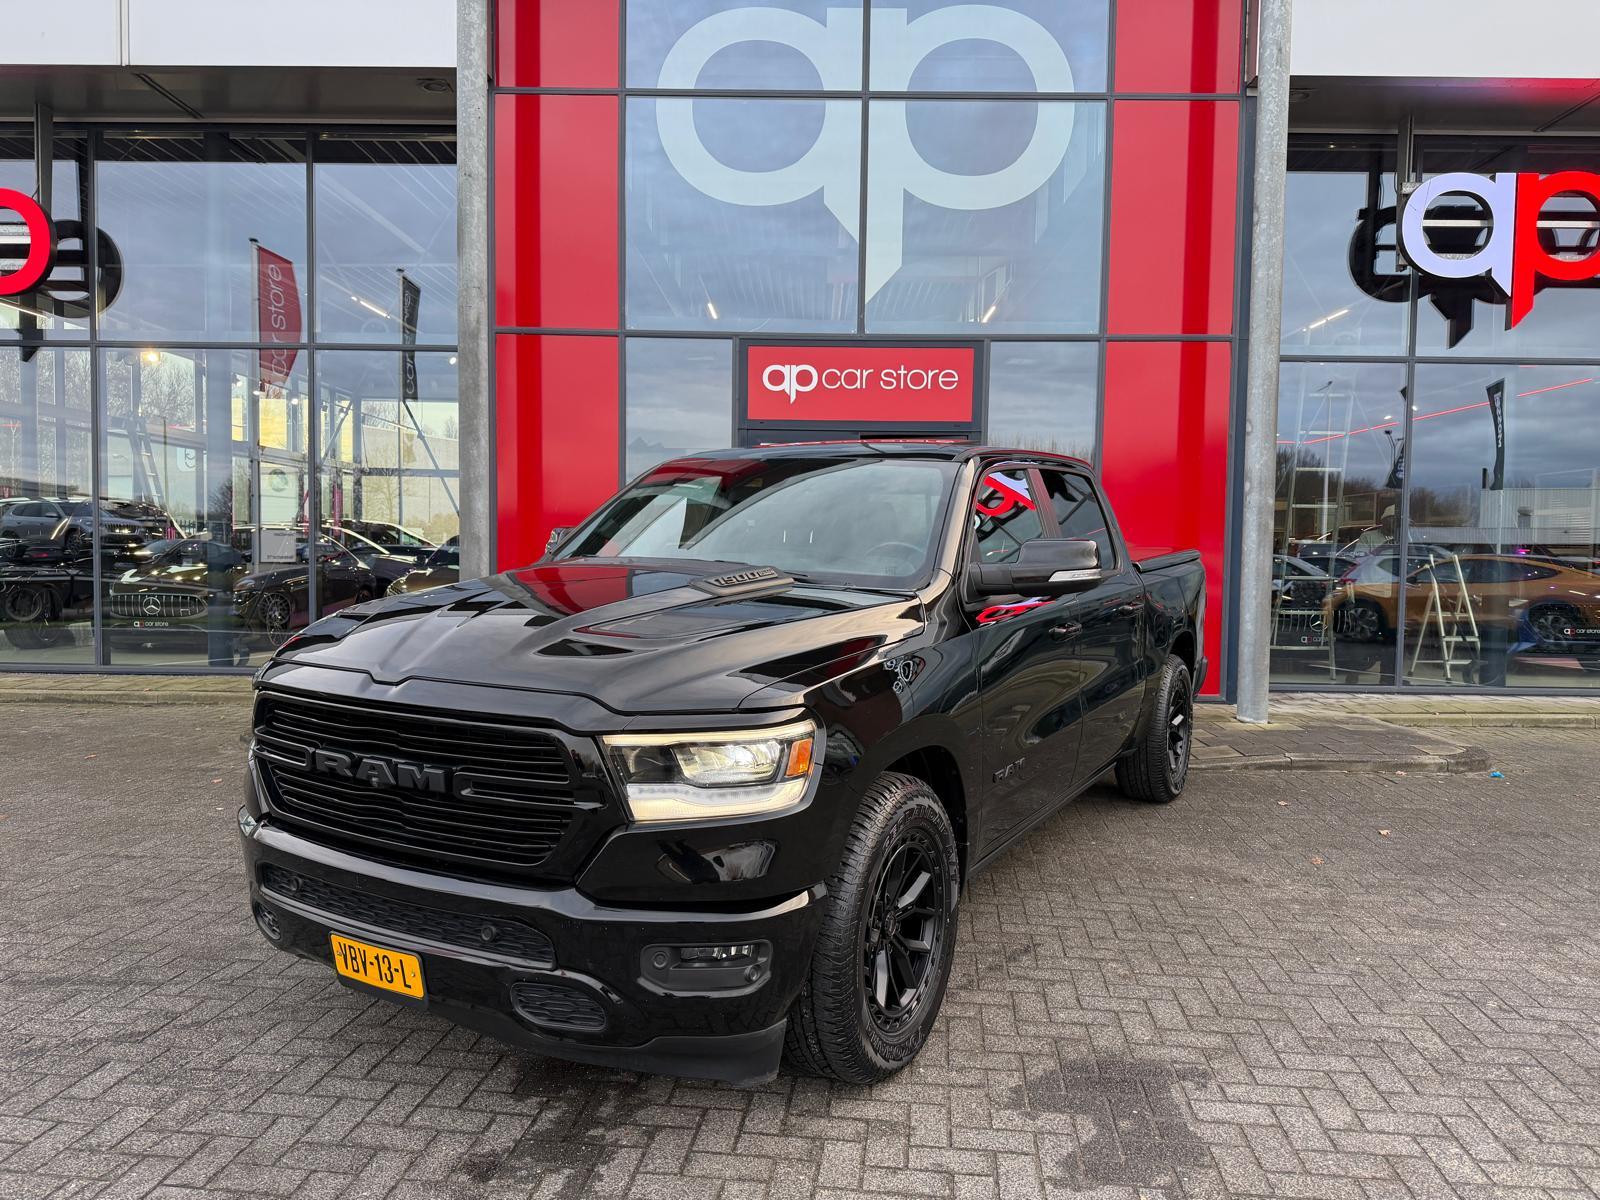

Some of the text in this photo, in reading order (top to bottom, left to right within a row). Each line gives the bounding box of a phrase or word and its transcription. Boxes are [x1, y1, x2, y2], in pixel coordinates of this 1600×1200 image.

[656, 4, 1075, 304] ap
[1402, 171, 1600, 329] ap
[267, 264, 287, 331] store
[406, 351, 415, 395] car
[762, 364, 959, 404] ap car store
[315, 749, 446, 793] RAM
[337, 941, 412, 989] VBV-13-L
